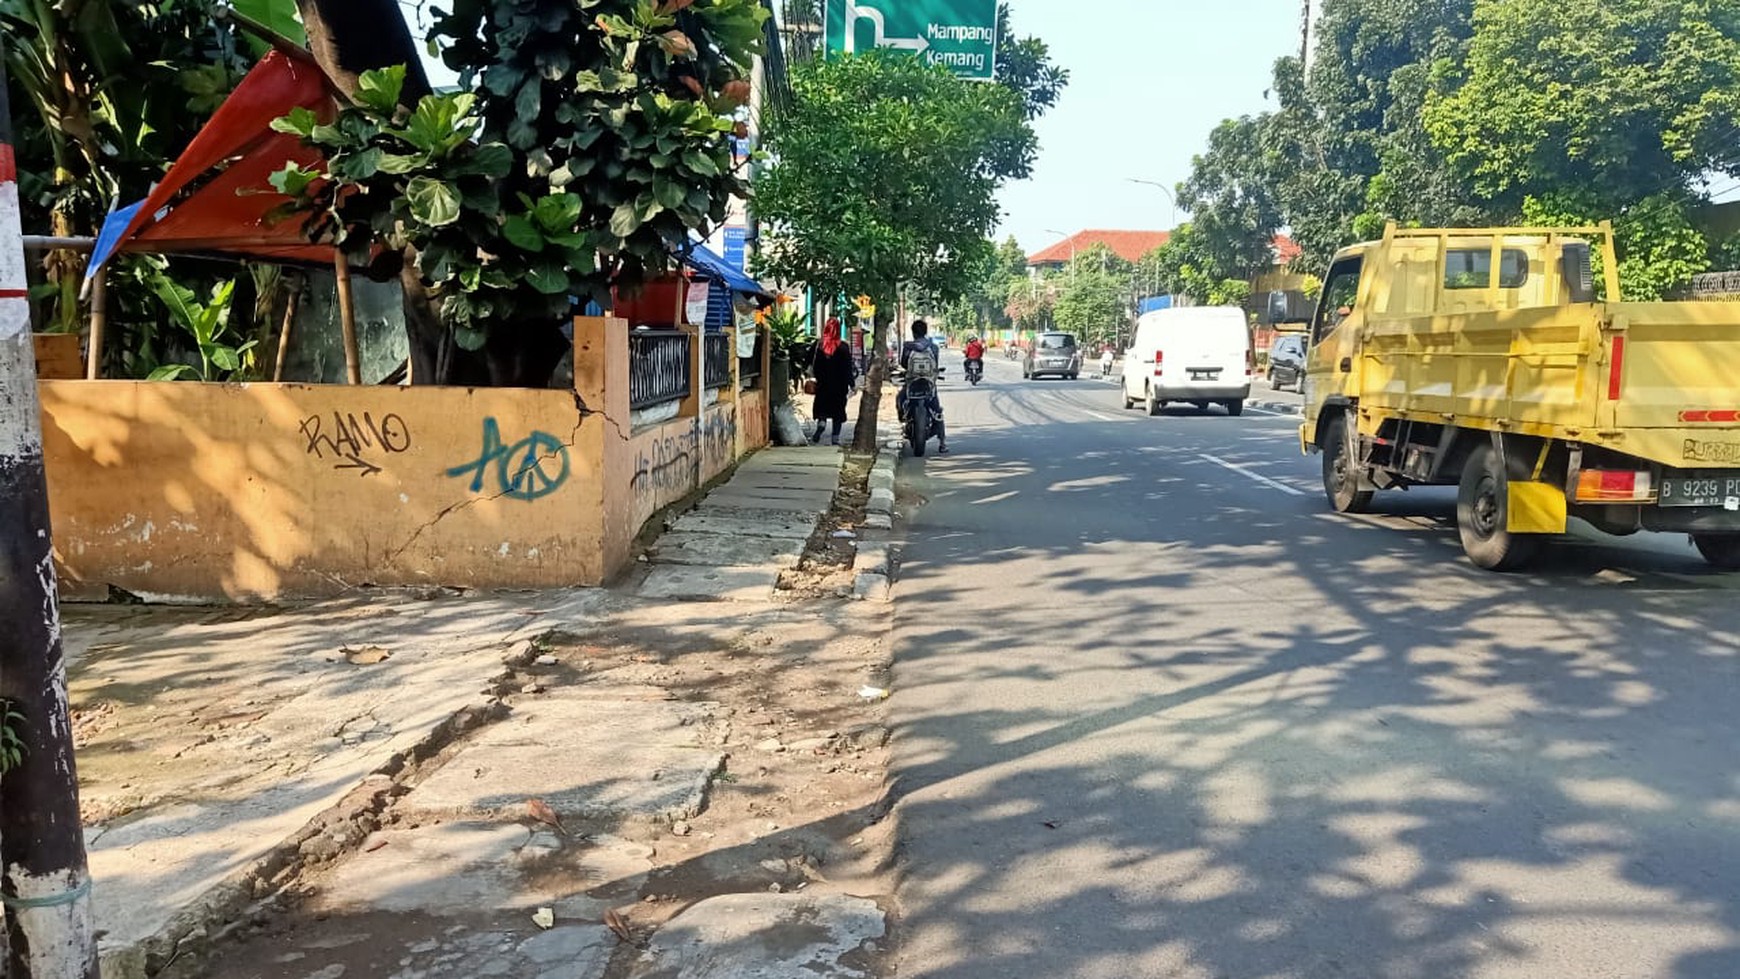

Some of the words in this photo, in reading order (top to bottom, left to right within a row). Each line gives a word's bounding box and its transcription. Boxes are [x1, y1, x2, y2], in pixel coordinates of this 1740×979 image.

[927, 23, 993, 45] Mampang
[926, 50, 984, 69] Kemang
[298, 411, 411, 458] RAMO
[1663, 482, 1672, 497] B
[1683, 480, 1718, 496] 9239
